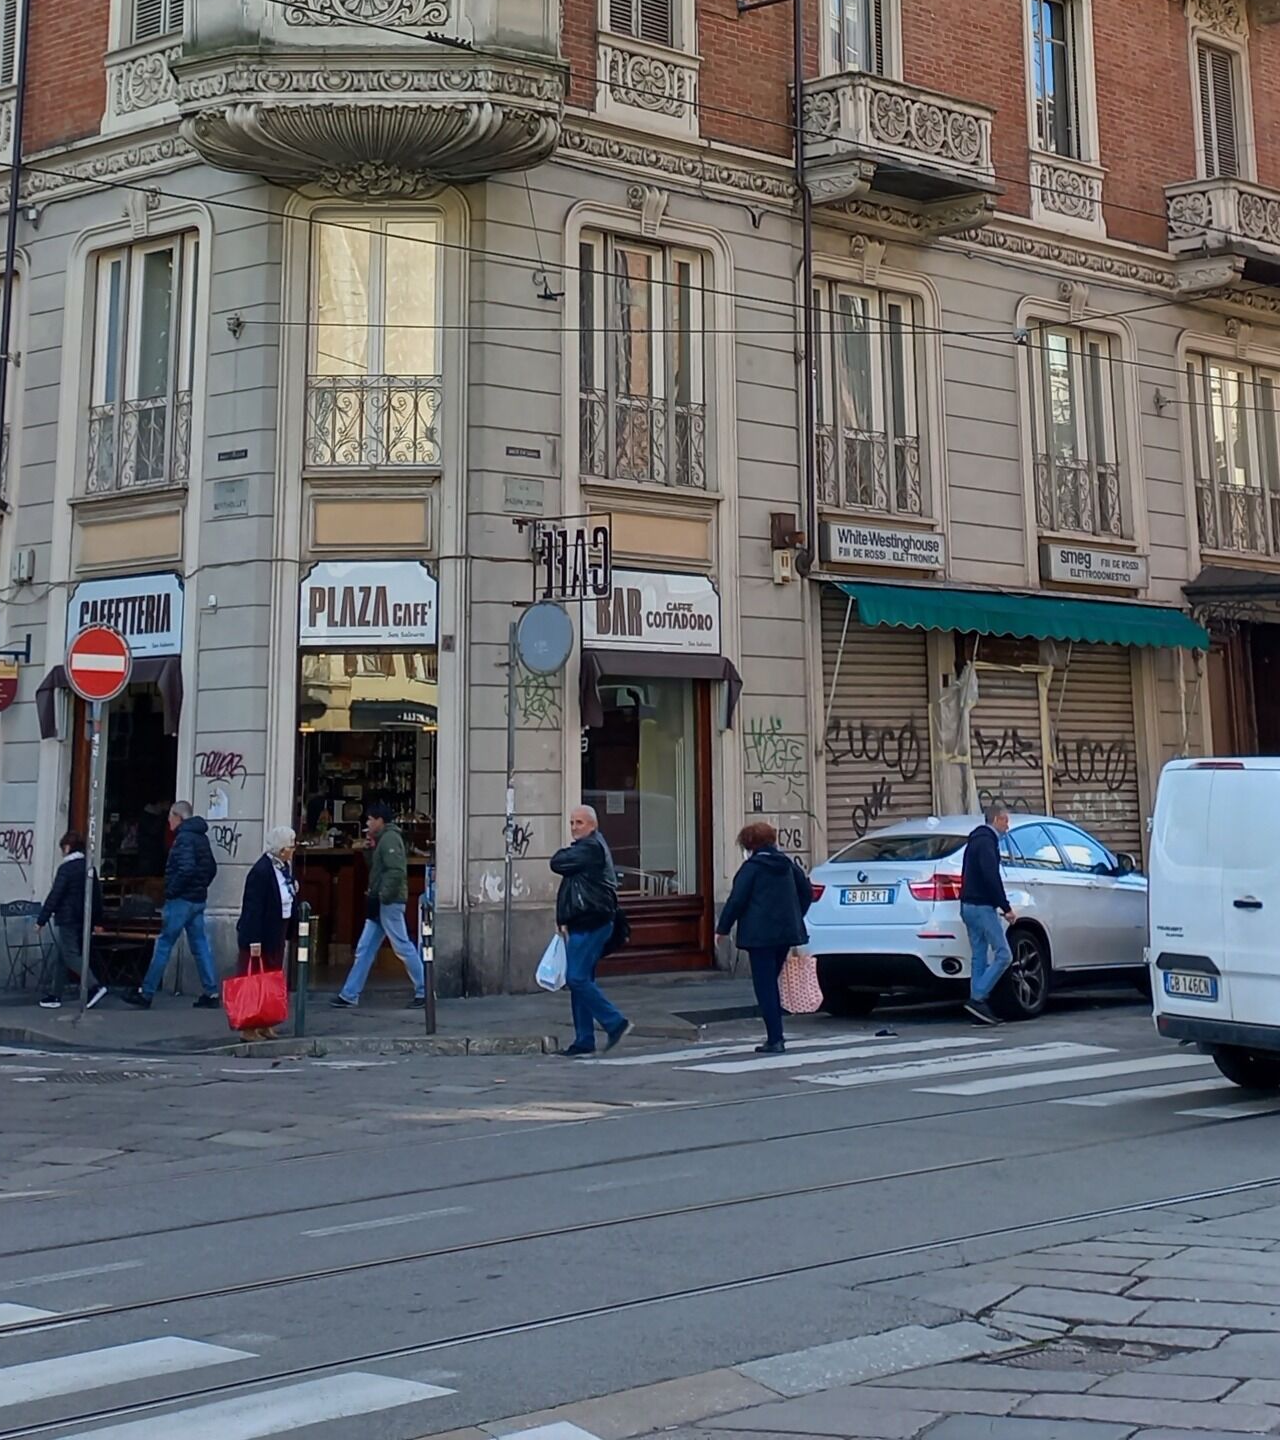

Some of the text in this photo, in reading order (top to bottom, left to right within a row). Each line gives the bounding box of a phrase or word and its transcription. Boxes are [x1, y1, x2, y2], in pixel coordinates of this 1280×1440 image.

[853, 549, 863, 558] DE
[1060, 550, 1091, 569] smeg
[79, 593, 170, 635] CAFFETTERIA
[308, 586, 389, 627] PLAZA
[596, 587, 642, 636] BAR
[646, 611, 713, 631] COSTADORO
